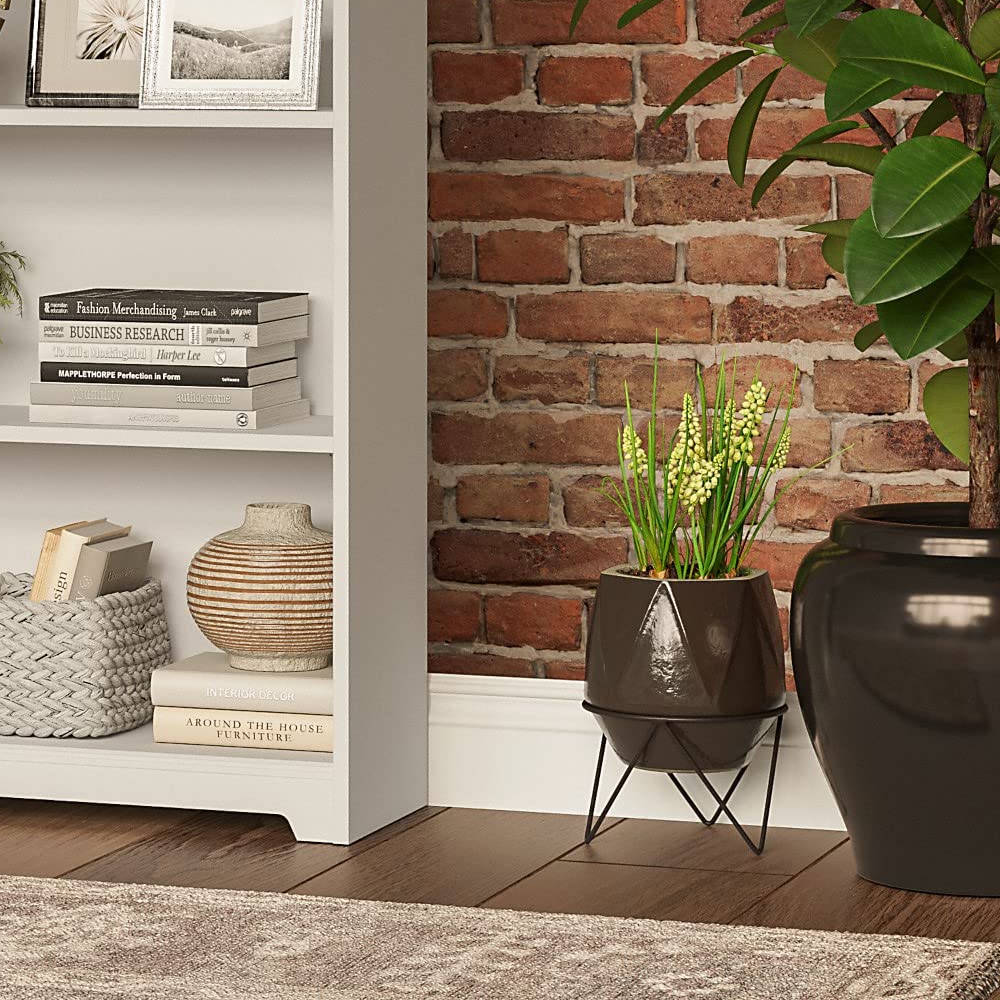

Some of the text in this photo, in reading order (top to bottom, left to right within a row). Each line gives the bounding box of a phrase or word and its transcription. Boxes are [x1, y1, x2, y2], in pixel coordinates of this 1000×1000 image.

[76, 300, 178, 320] Fashion Merchandising
[183, 307, 217, 317] James Clark
[70, 326, 185, 341] BUSINESS RESEARCH
[90, 346, 146, 361] Mockingbird
[156, 349, 201, 362] Harper Lee
[58, 369, 181, 380] MAPPLETHORPE Perfection in Form
[207, 394, 231, 404] name
[206, 687, 295, 701] INTERIOR DECOR
[185, 717, 324, 734] AROUND THE HOUSE
[216, 730, 293, 742] FURNITURE
